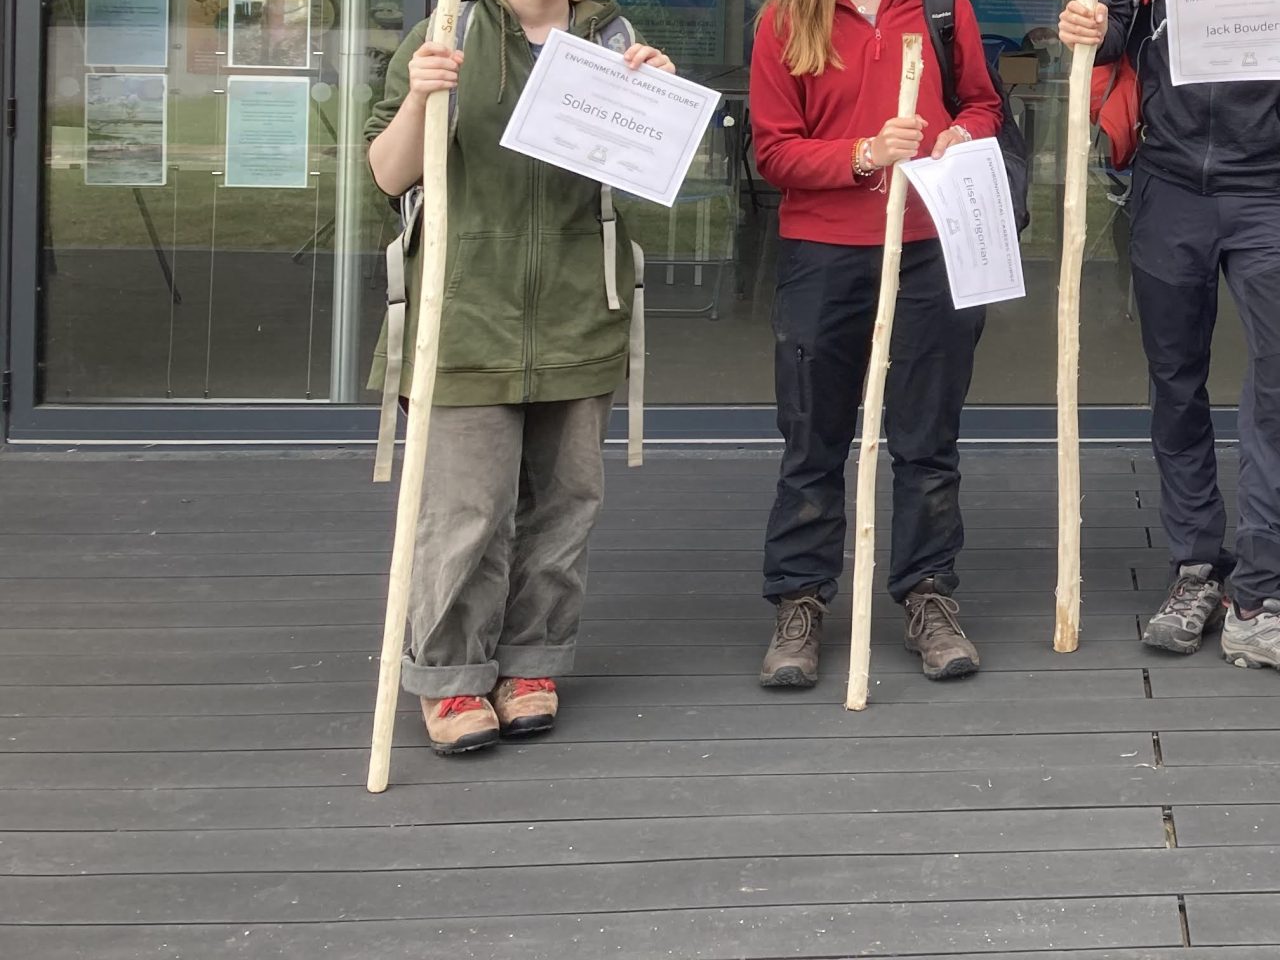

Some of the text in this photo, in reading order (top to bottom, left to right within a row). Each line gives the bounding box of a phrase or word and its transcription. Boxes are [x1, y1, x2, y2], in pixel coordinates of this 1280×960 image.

[441, 14, 454, 33] Sol
[1206, 23, 1230, 37] Jack
[565, 52, 630, 82] ENVIRONMENTAL
[632, 77, 666, 97] CAREERS
[667, 92, 700, 109] COURSE
[562, 93, 608, 120] Solaris
[611, 111, 664, 141] Roberts
[987, 157, 1004, 217] ENVIRONMENTAL
[963, 177, 977, 205] Elise
[973, 208, 989, 266] Grigorian
